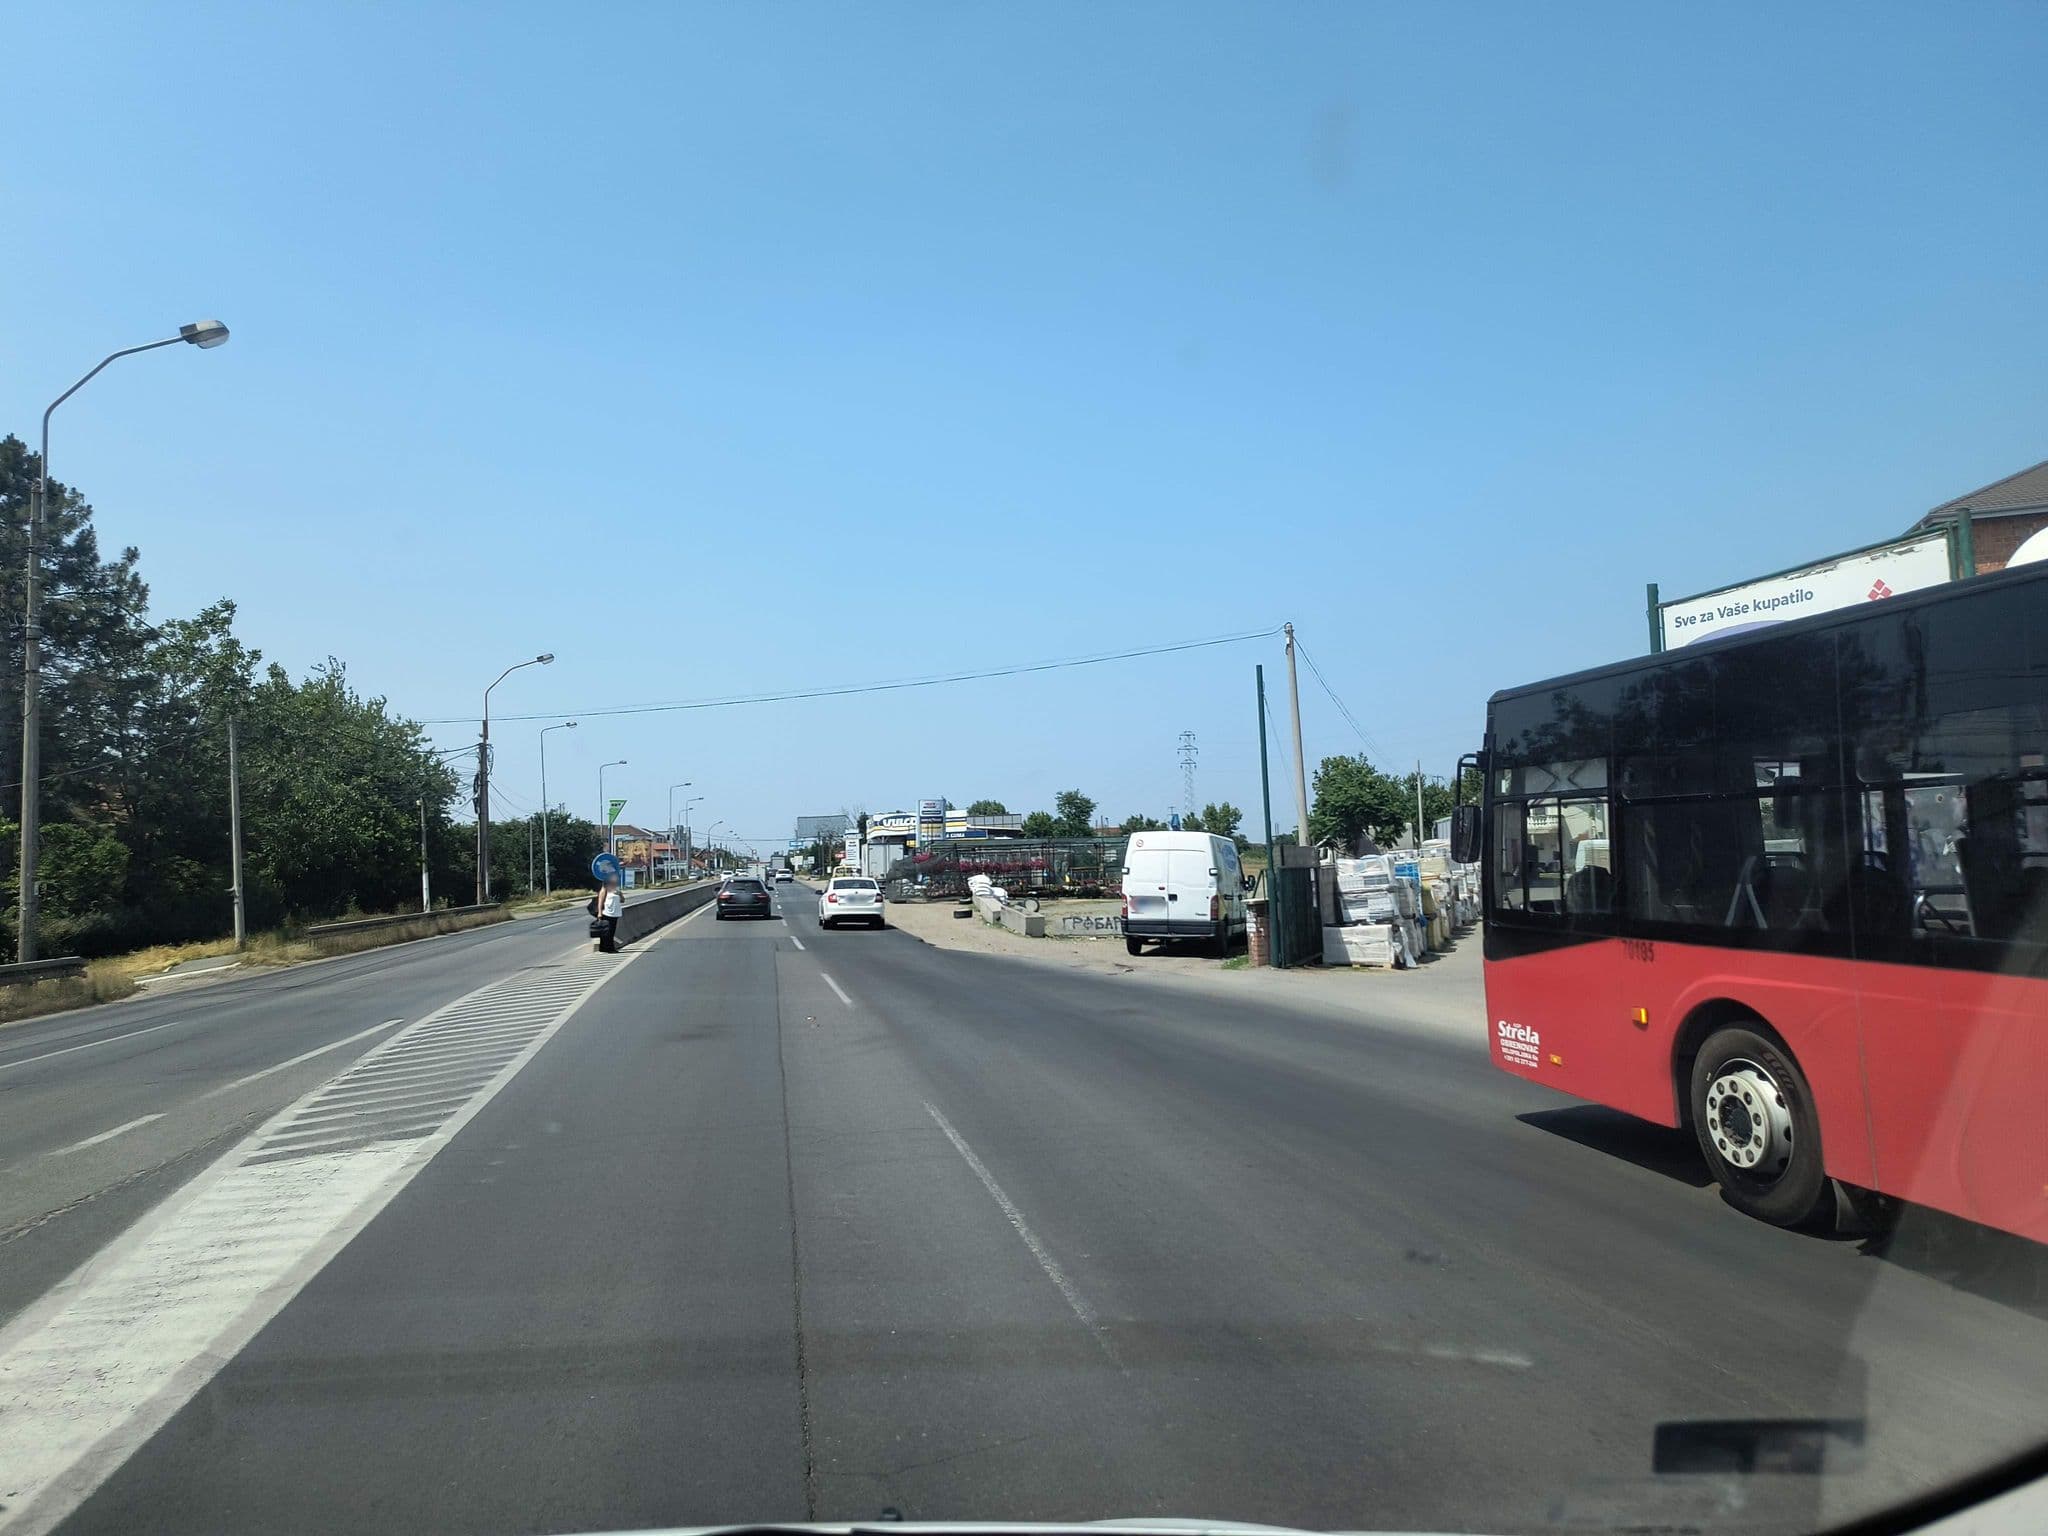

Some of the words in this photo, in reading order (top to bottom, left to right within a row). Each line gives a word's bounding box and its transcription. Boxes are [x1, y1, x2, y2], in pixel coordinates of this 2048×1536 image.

[1674, 613, 1697, 628] Sve
[1699, 611, 1715, 624] za
[1717, 602, 1750, 619] Vaše
[1753, 589, 1814, 615] kupatilo
[1498, 1020, 1540, 1044] Strela
